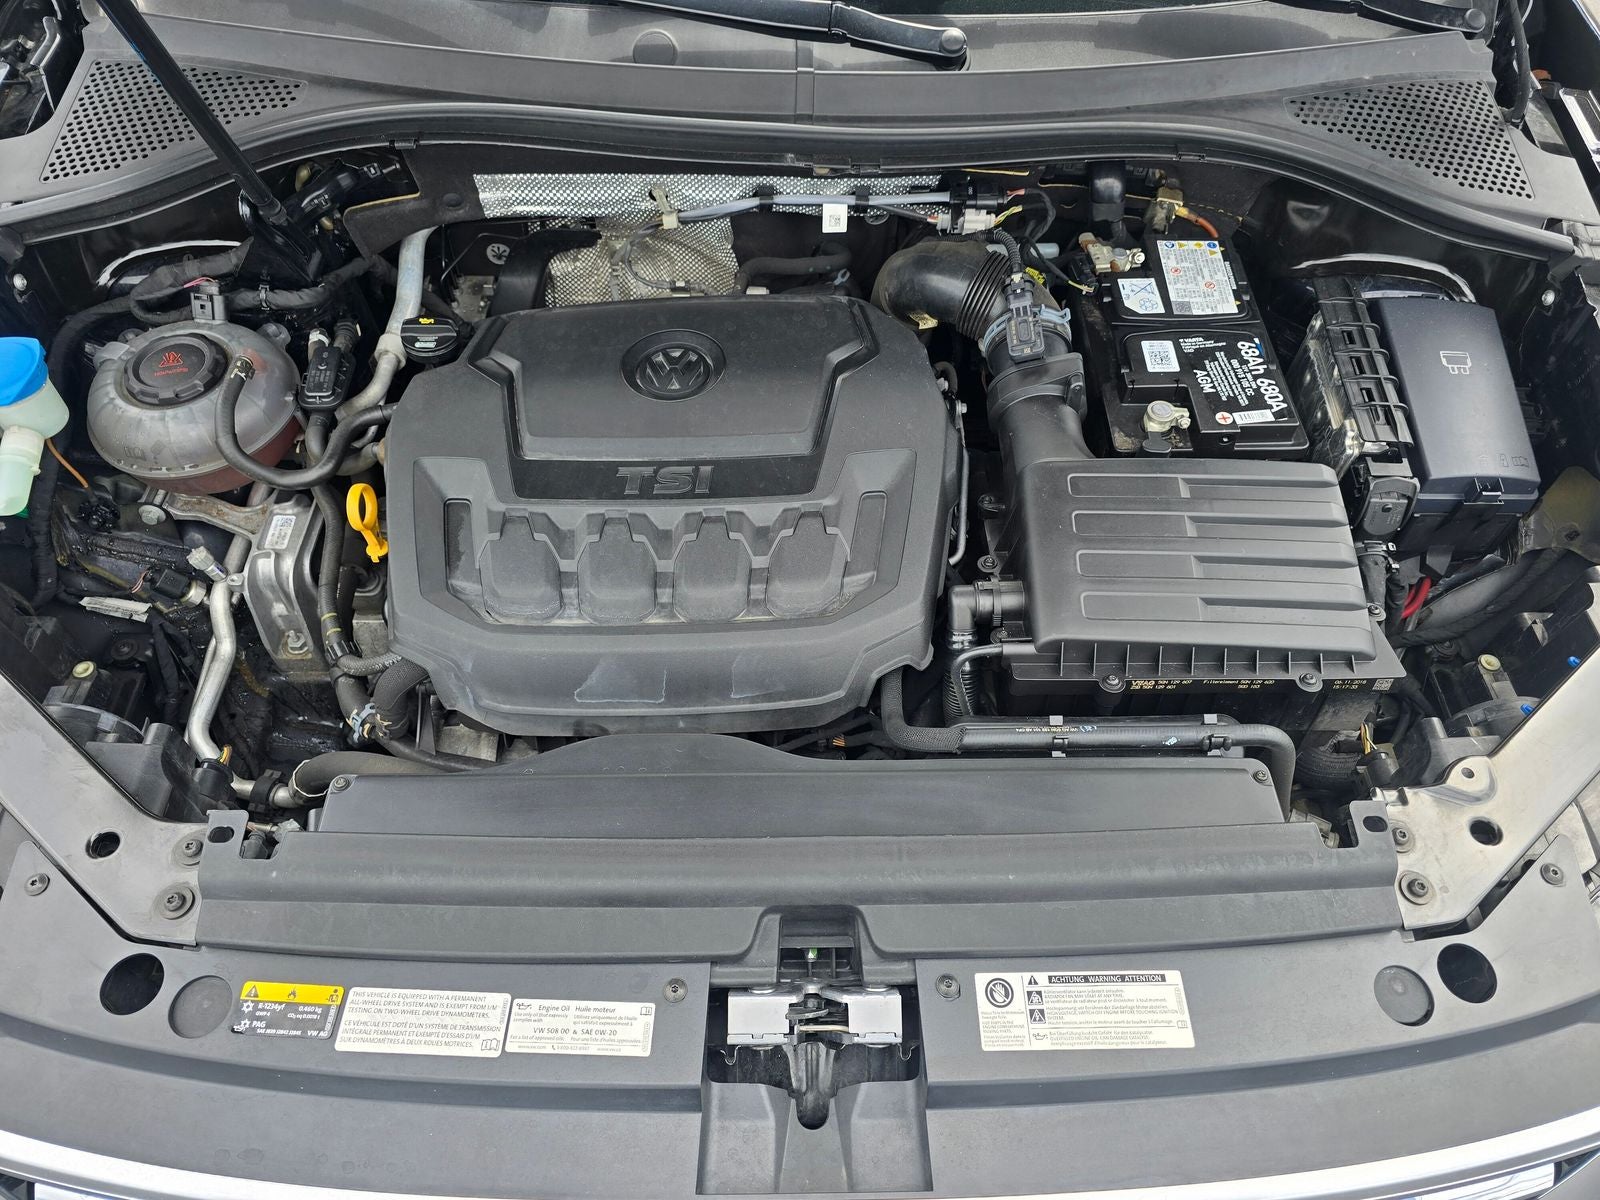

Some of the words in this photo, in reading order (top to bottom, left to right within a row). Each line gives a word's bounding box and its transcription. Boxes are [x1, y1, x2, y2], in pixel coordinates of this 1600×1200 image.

[1193, 369, 1217, 393] AGM
[1236, 341, 1268, 375] 68Ah
[1256, 377, 1288, 413] 680A
[615, 465, 715, 495] TSI
[1051, 975, 1085, 983] ACHTUNG
[1086, 975, 1122, 983] WARNING
[1124, 974, 1162, 982] ATTENTION
[366, 991, 390, 999] VEHICLE
[397, 992, 428, 1000] EQUIPPED
[450, 994, 487, 1002] PERMANENT
[257, 1002, 287, 1012] R-1234yf
[314, 1006, 323, 1014] kg
[349, 999, 382, 1007] ALL-WHEEL
[401, 1000, 424, 1008] SYSTEM
[424, 1001, 439, 1009] AND
[445, 1002, 469, 1010] EXEMPT
[538, 1004, 560, 1013] Engine
[560, 1004, 571, 1012] Oil
[575, 1005, 592, 1013] Huile
[347, 1006, 373, 1014] TESTING
[384, 1008, 421, 1016] TWO-WHEEL
[421, 1009, 440, 1017] DRIVE
[251, 1020, 266, 1028] PAG
[457, 1024, 502, 1032] TRANSMISSION
[372, 1029, 408, 1037] PERMANENT
[560, 1027, 570, 1035] 00
[581, 1028, 593, 1036] SAE
